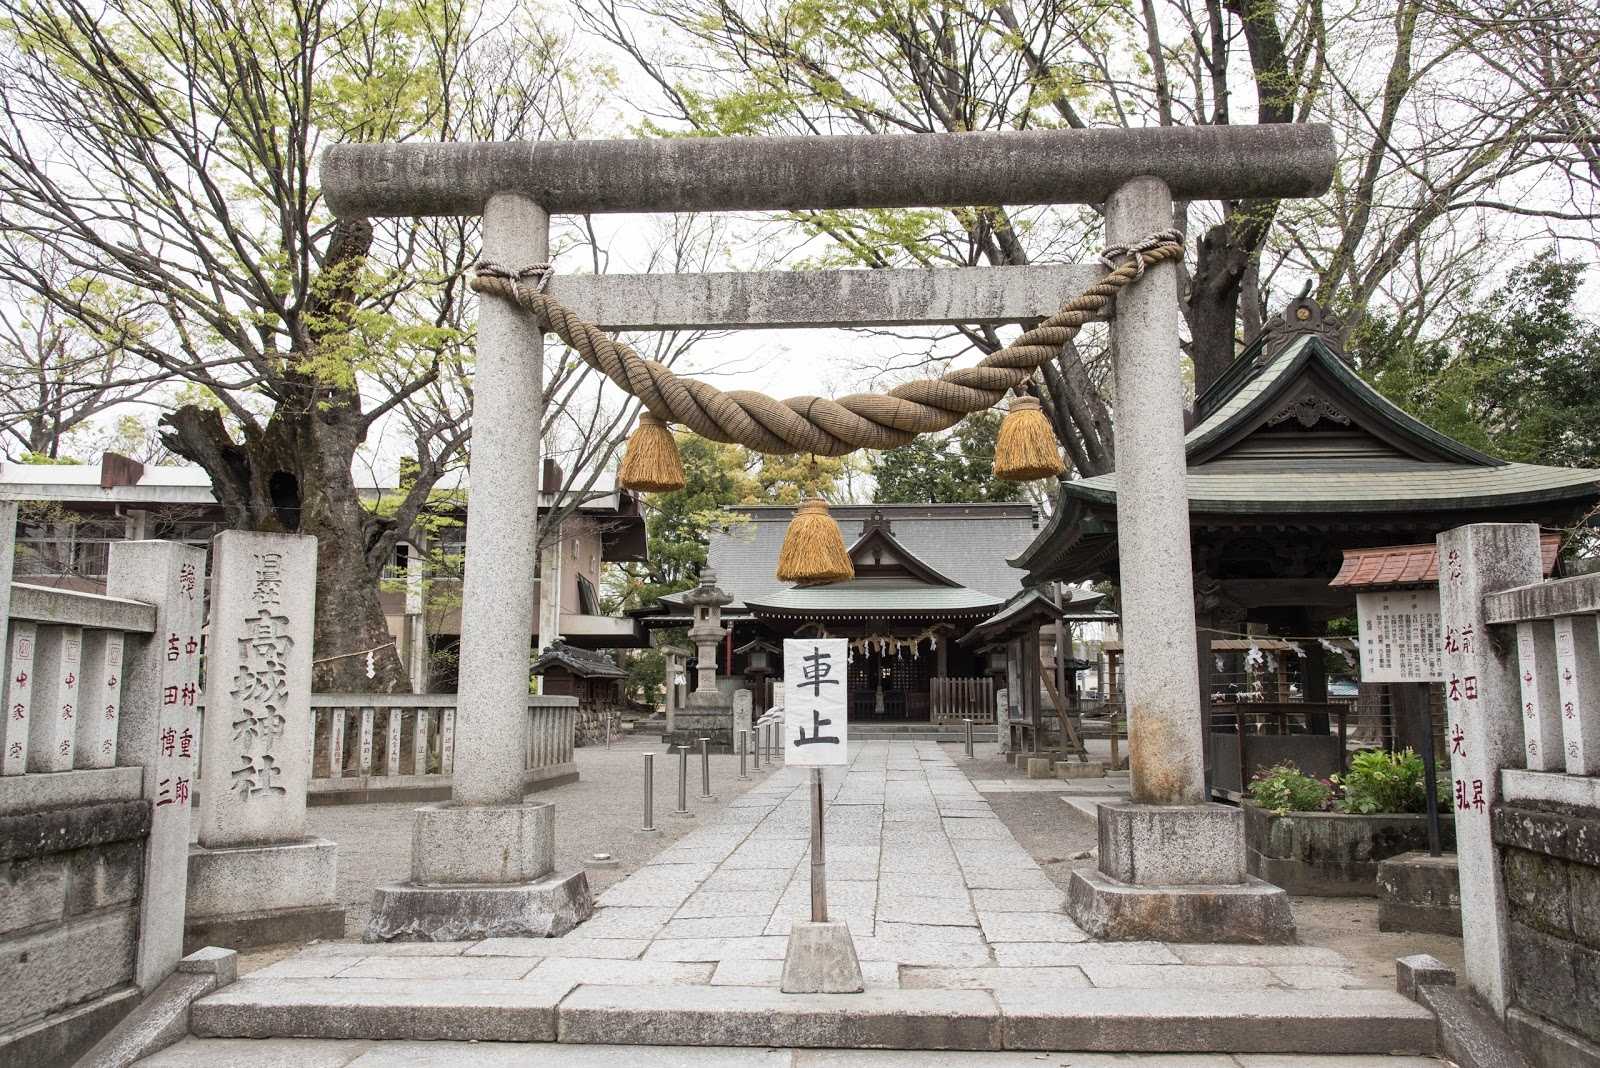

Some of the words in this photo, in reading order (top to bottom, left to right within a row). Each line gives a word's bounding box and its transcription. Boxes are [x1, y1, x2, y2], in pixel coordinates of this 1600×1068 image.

[794, 646, 840, 748] 車止
[1462, 623, 1486, 815] 前田昇
